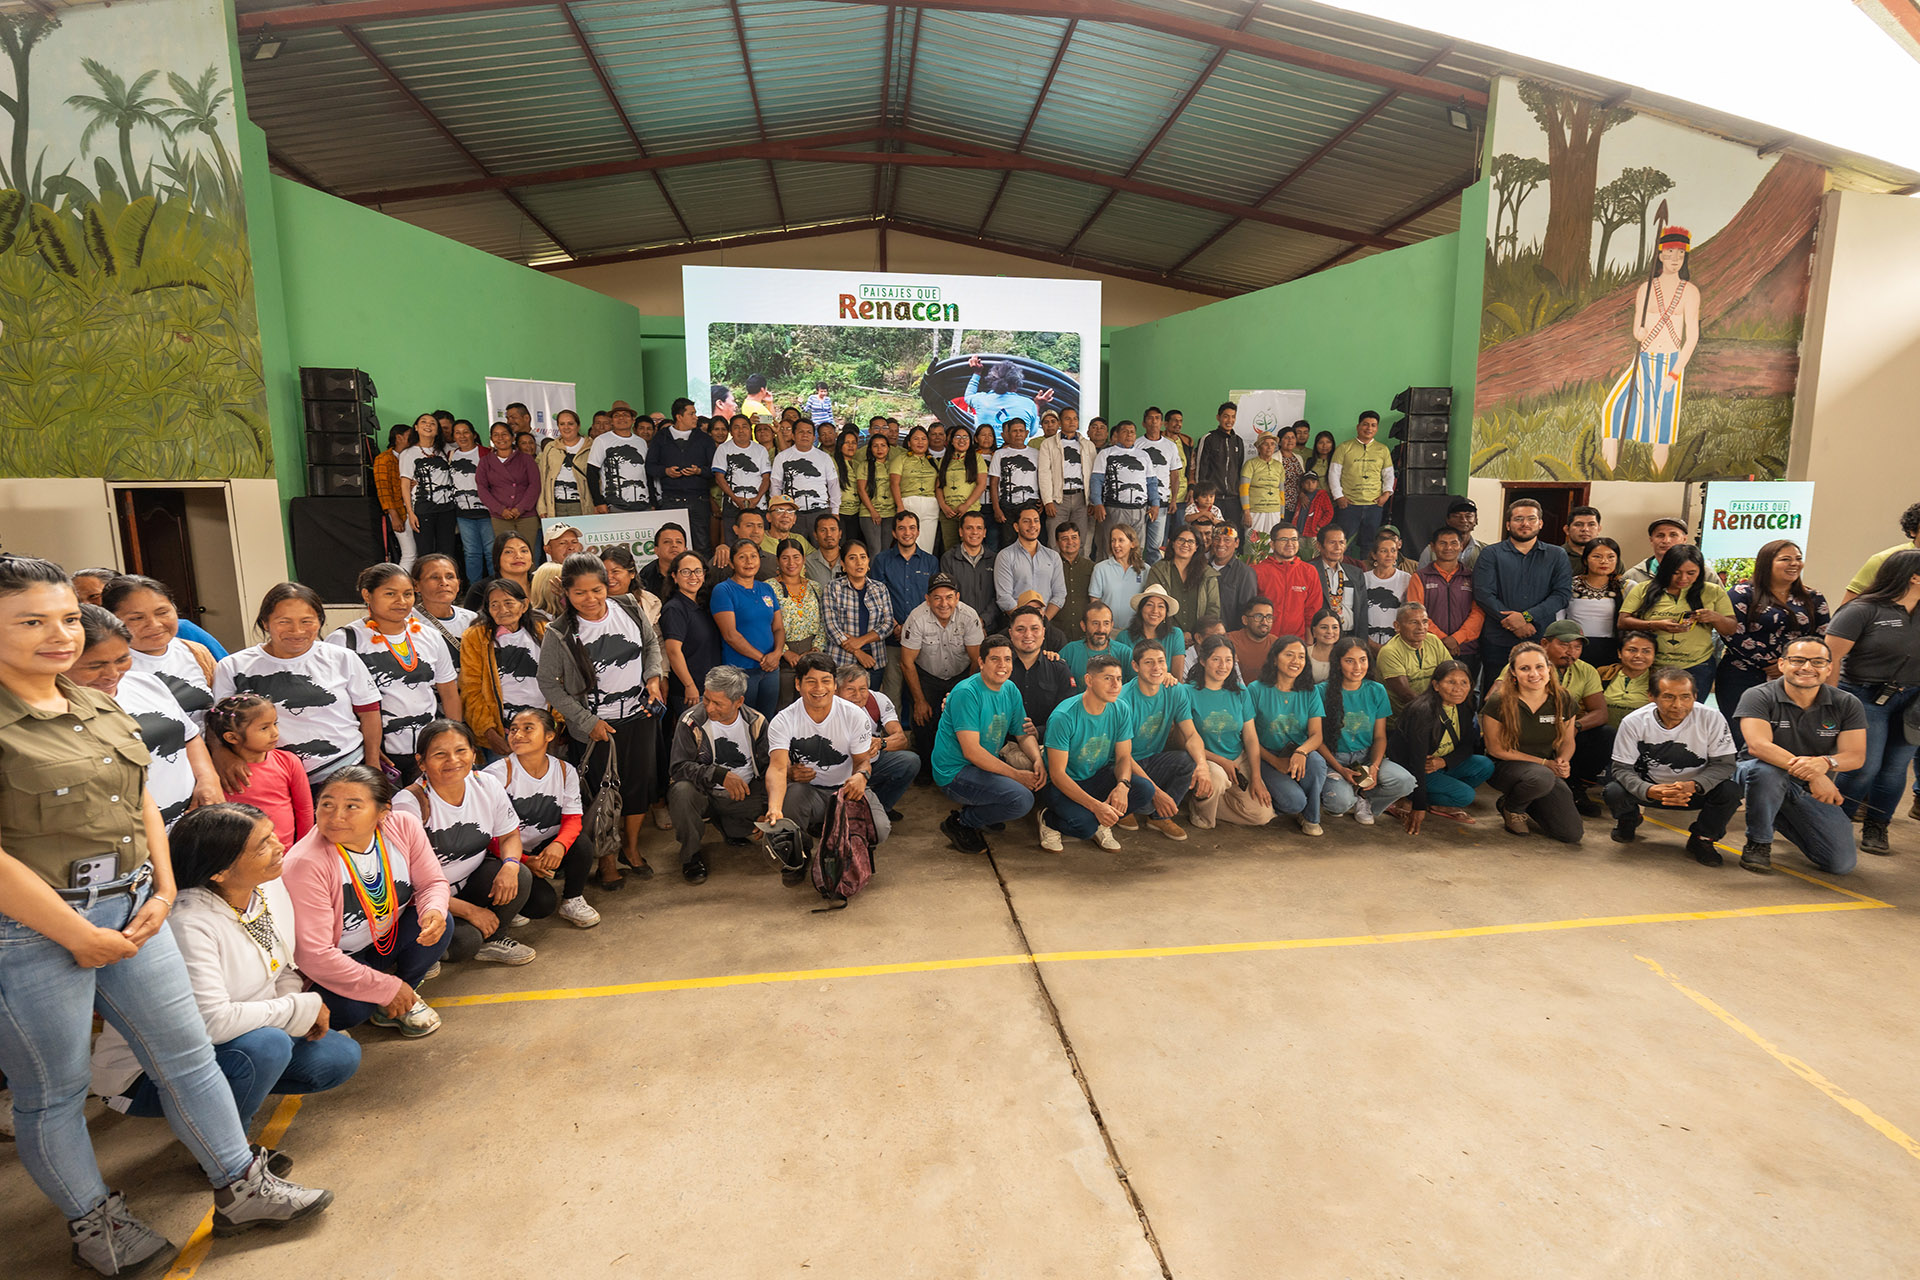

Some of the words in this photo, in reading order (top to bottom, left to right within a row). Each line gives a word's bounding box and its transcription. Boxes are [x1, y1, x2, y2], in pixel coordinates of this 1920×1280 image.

[864, 287, 911, 298] PAISAJES
[917, 289, 937, 299] QUE
[839, 294, 959, 322] Renacen
[1732, 503, 1768, 511] PAISAJES
[1772, 503, 1787, 511] QUE
[1712, 509, 1801, 530] Renacen
[588, 532, 630, 542] PAISAJES
[635, 530, 652, 539] QUE
